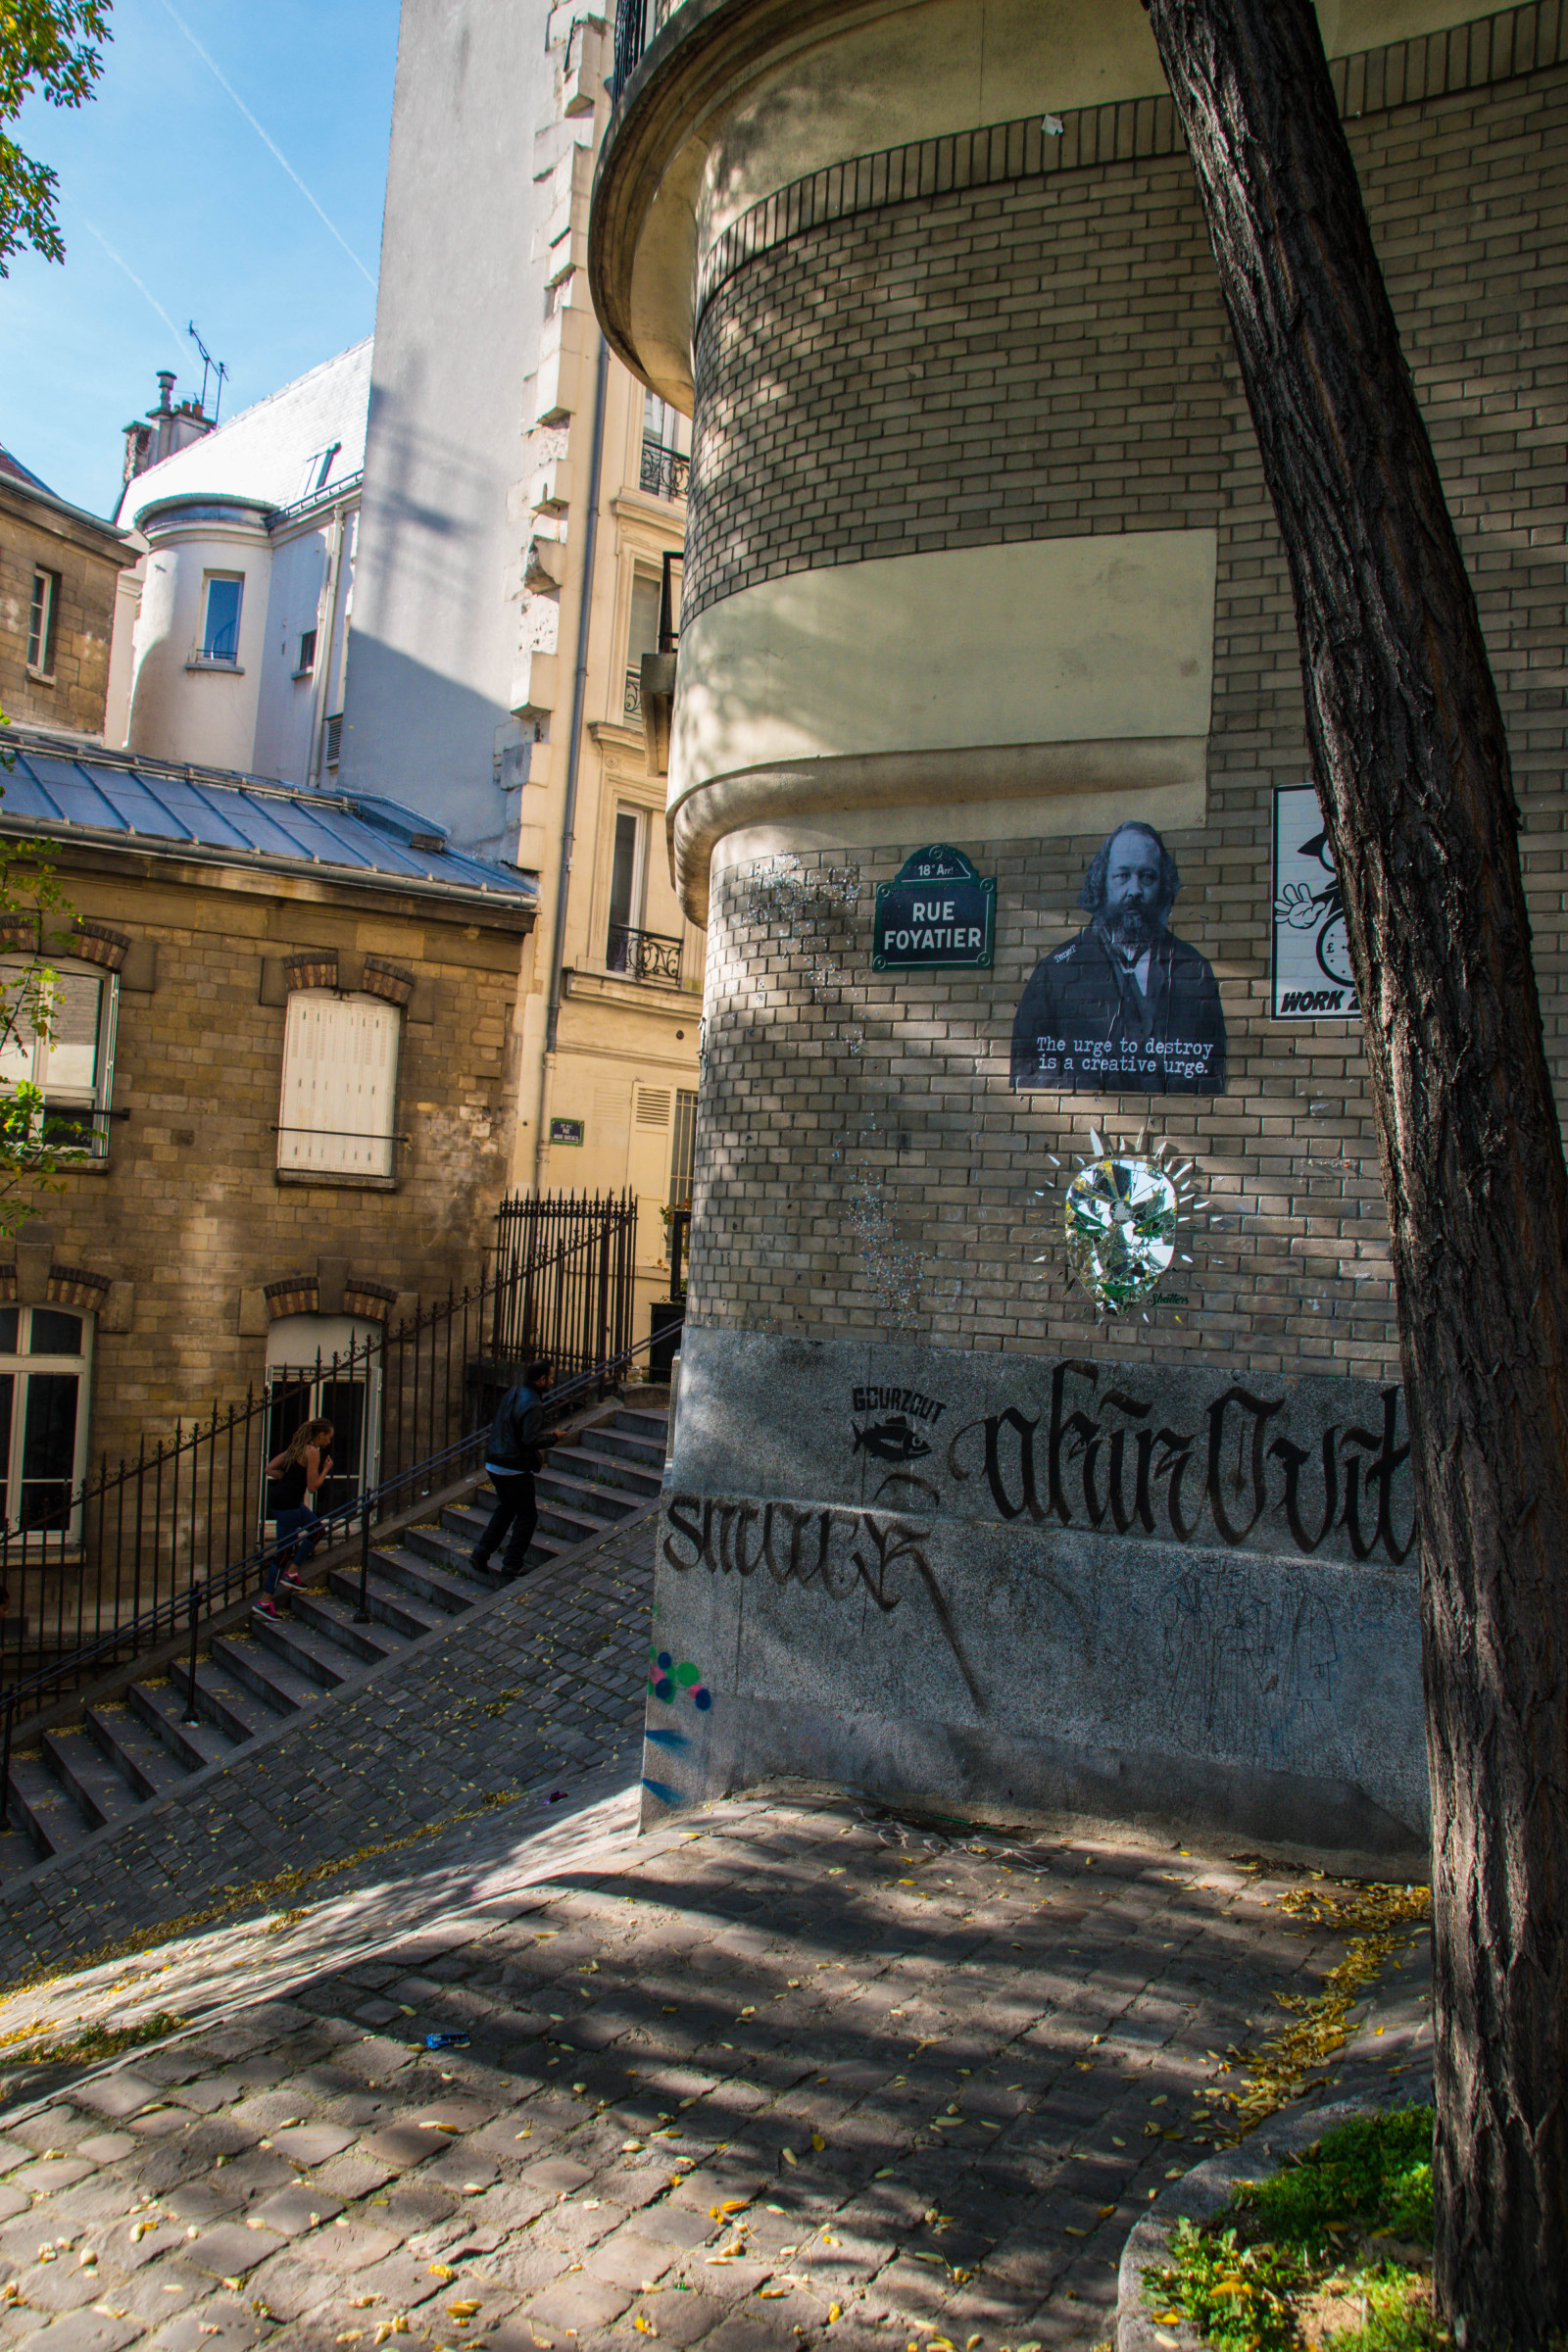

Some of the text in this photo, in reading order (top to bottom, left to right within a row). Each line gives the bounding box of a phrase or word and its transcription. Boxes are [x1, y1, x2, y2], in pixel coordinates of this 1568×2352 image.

[912, 901, 956, 922] RUE
[884, 927, 982, 951] FOYATIER
[1280, 990, 1346, 1013] WORK
[1037, 1036, 1213, 1059] The urge to destroy
[1039, 1054, 1208, 1078] is a creative urge.
